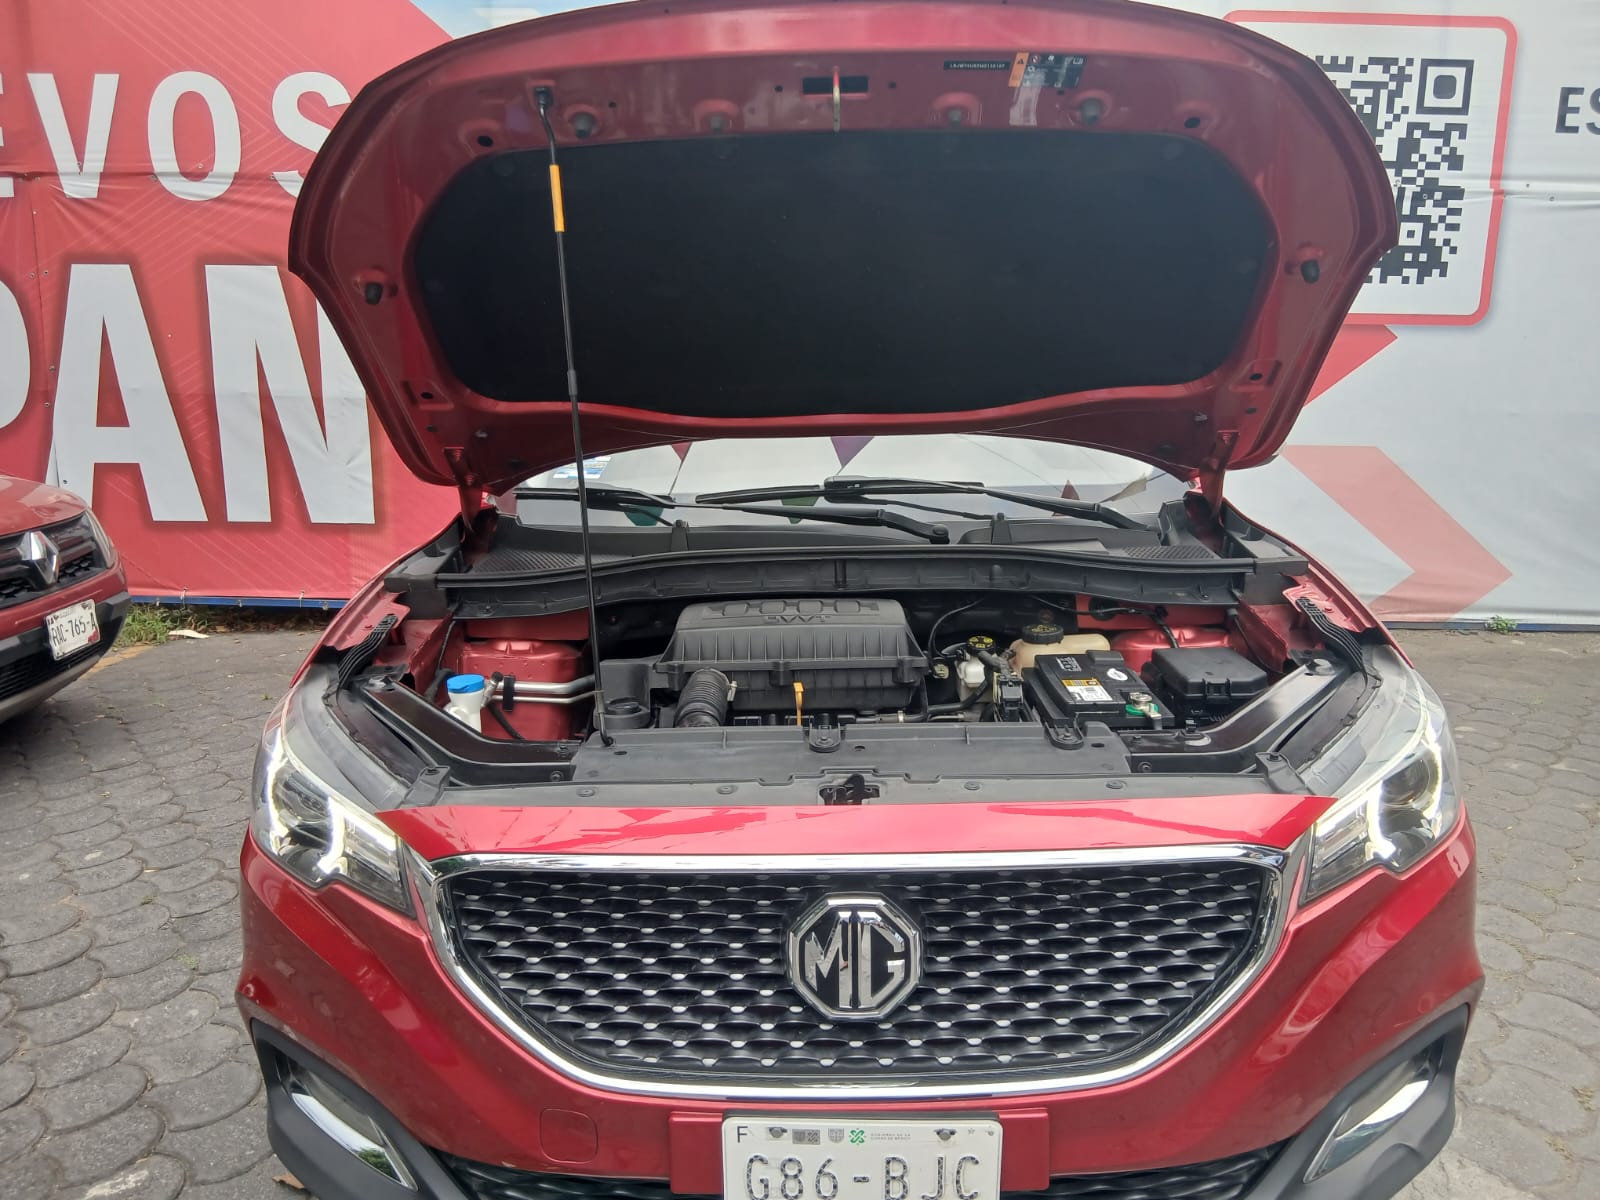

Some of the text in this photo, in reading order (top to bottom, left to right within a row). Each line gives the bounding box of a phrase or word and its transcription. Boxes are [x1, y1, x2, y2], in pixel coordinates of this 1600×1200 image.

[0, 71, 350, 200] VOS
[805, 911, 905, 1009] MG
[747, 1154, 980, 1200] G86-BJC
